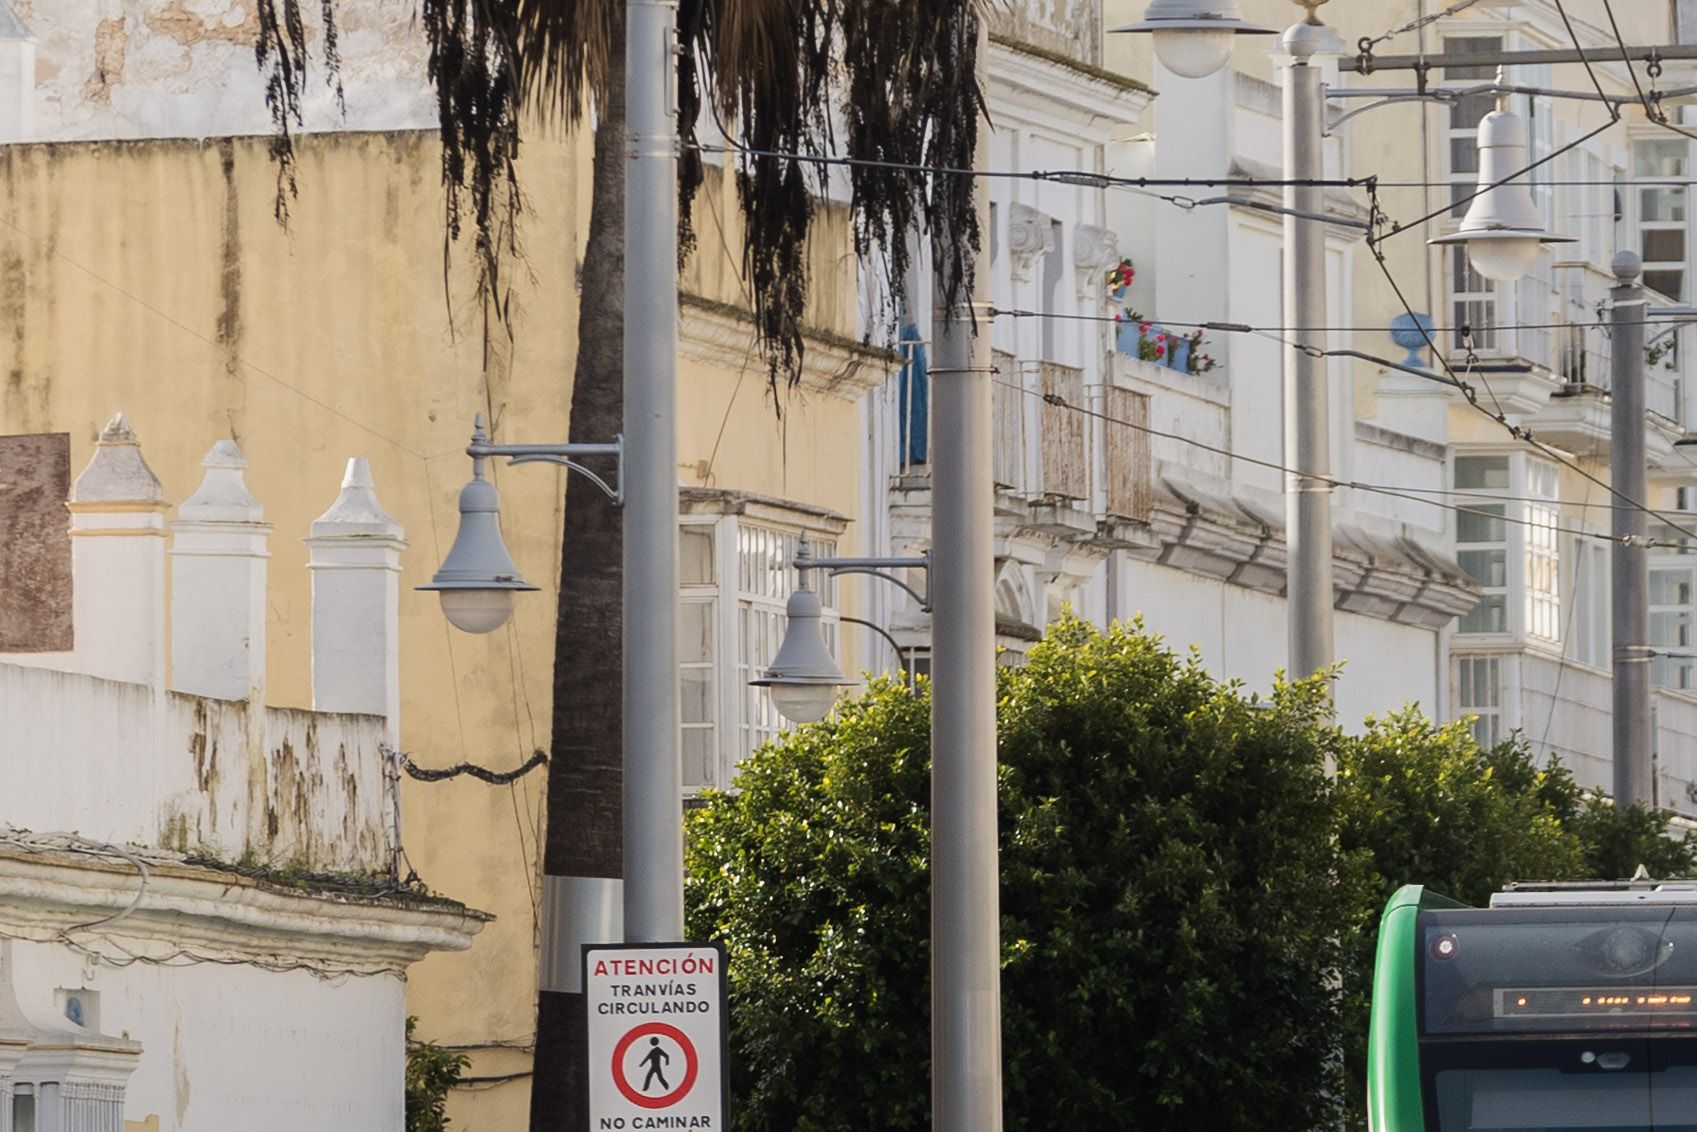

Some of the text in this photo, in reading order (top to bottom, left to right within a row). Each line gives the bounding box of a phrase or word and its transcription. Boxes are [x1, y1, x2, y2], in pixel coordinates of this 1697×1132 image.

[593, 953, 714, 976] ATENCIÓN
[610, 980, 697, 997] TRANVÍAS
[598, 1001, 710, 1015] CIRCULANDO
[600, 1115, 711, 1130] NO CAMINAR
